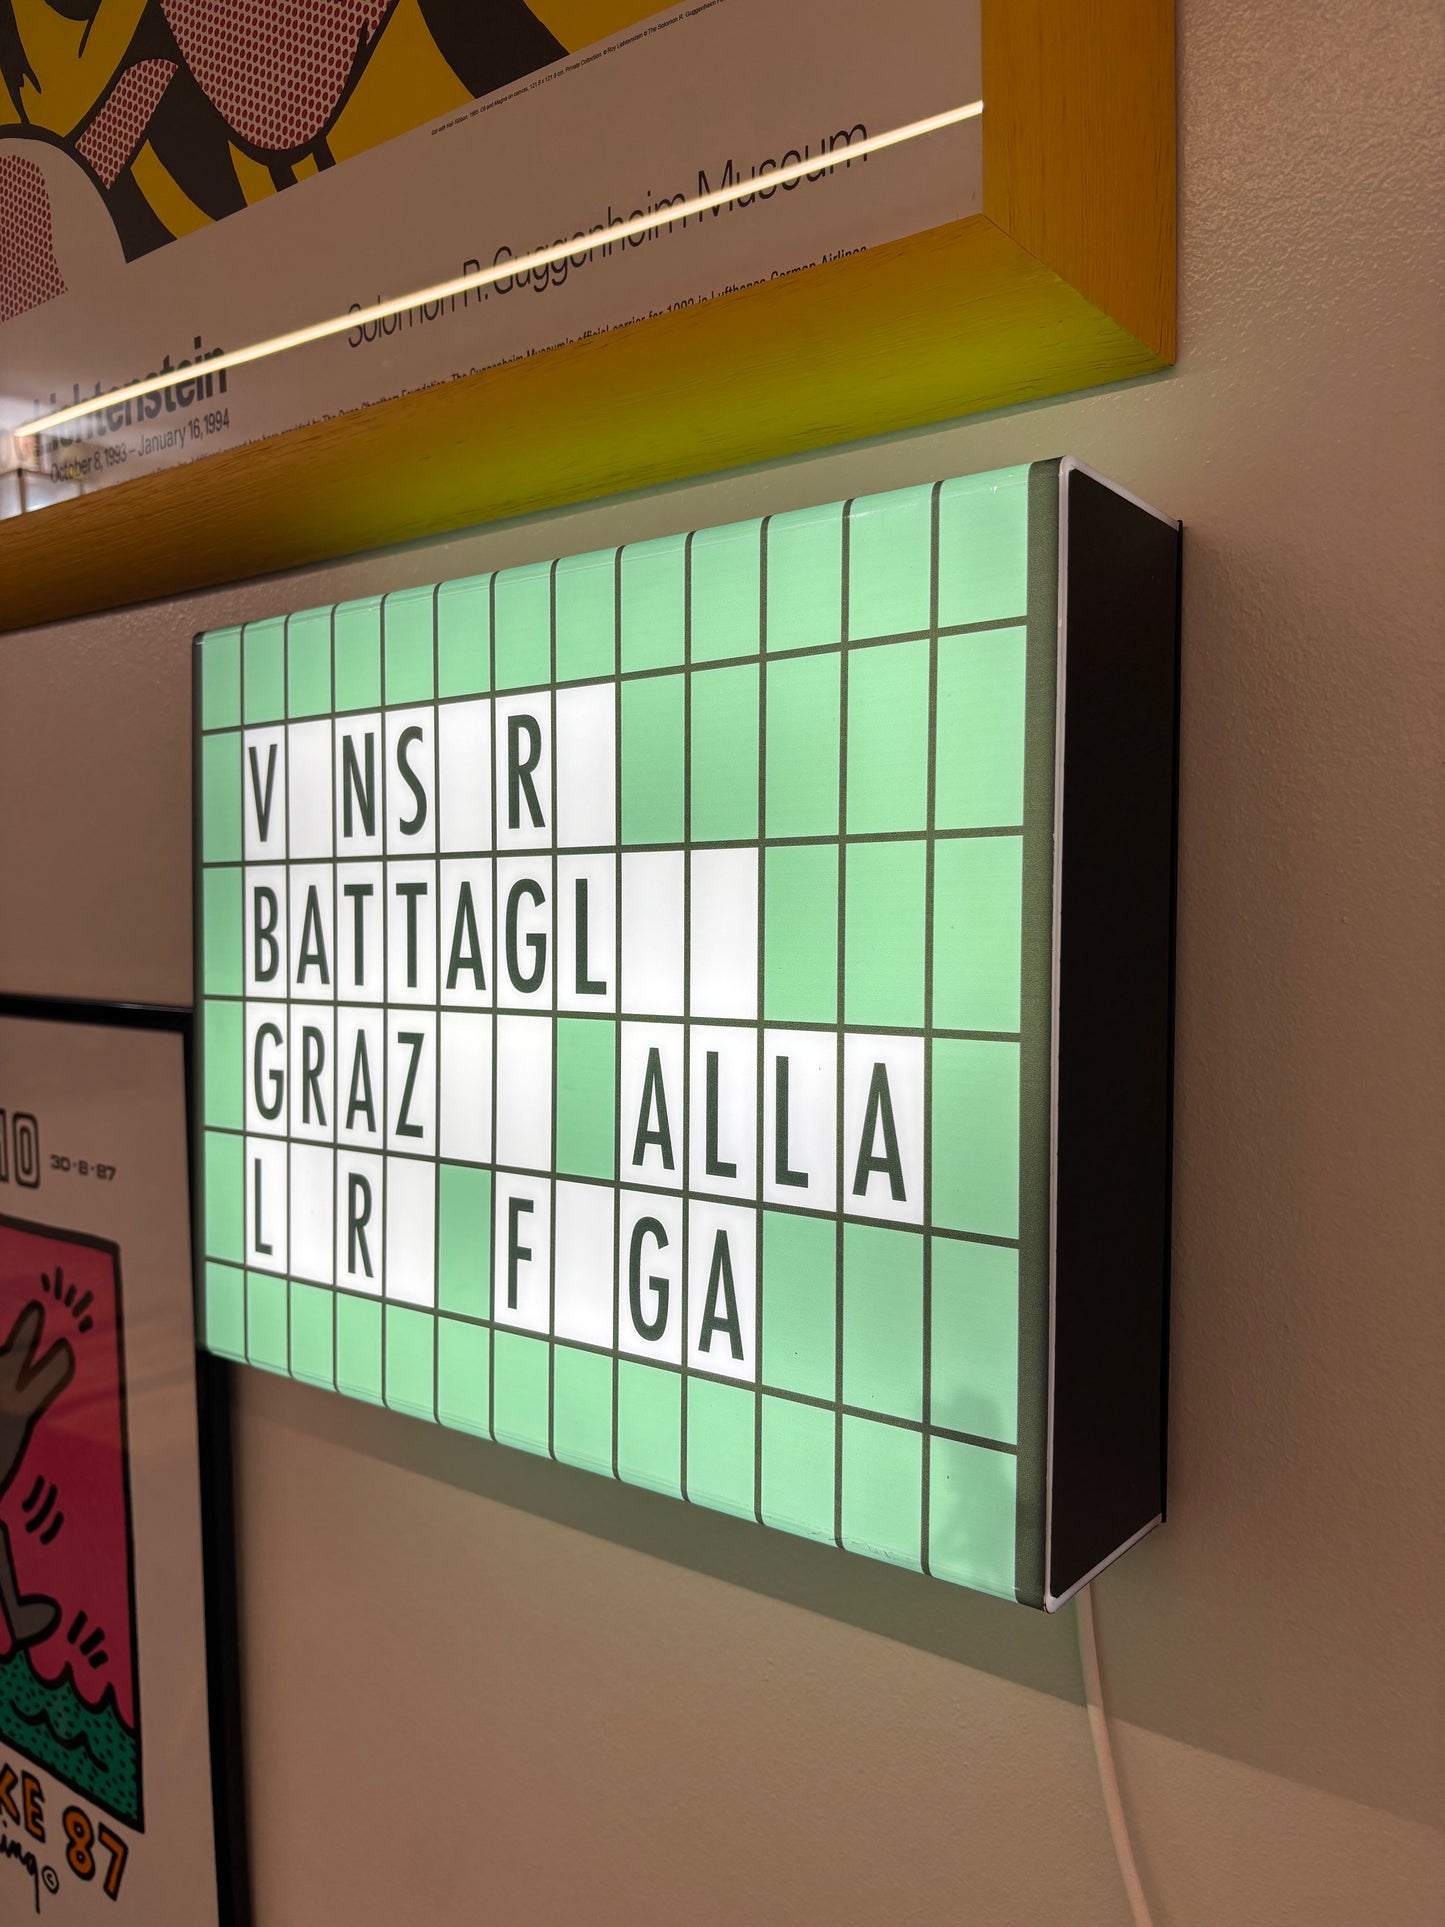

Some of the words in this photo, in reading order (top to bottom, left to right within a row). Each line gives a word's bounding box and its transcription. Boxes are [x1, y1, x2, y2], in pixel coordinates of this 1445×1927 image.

[51, 454, 92, 483] October
[104, 443, 128, 467] 1993
[138, 426, 186, 457] January
[187, 419, 204, 442] 16,
[204, 408, 231, 435] 1994
[253, 877, 608, 995] BATTAGL
[253, 1022, 425, 1139] GRAZ
[632, 1047, 908, 1203] ALLA
[628, 1215, 745, 1362] GA
[63, 1805, 129, 1902] 87
